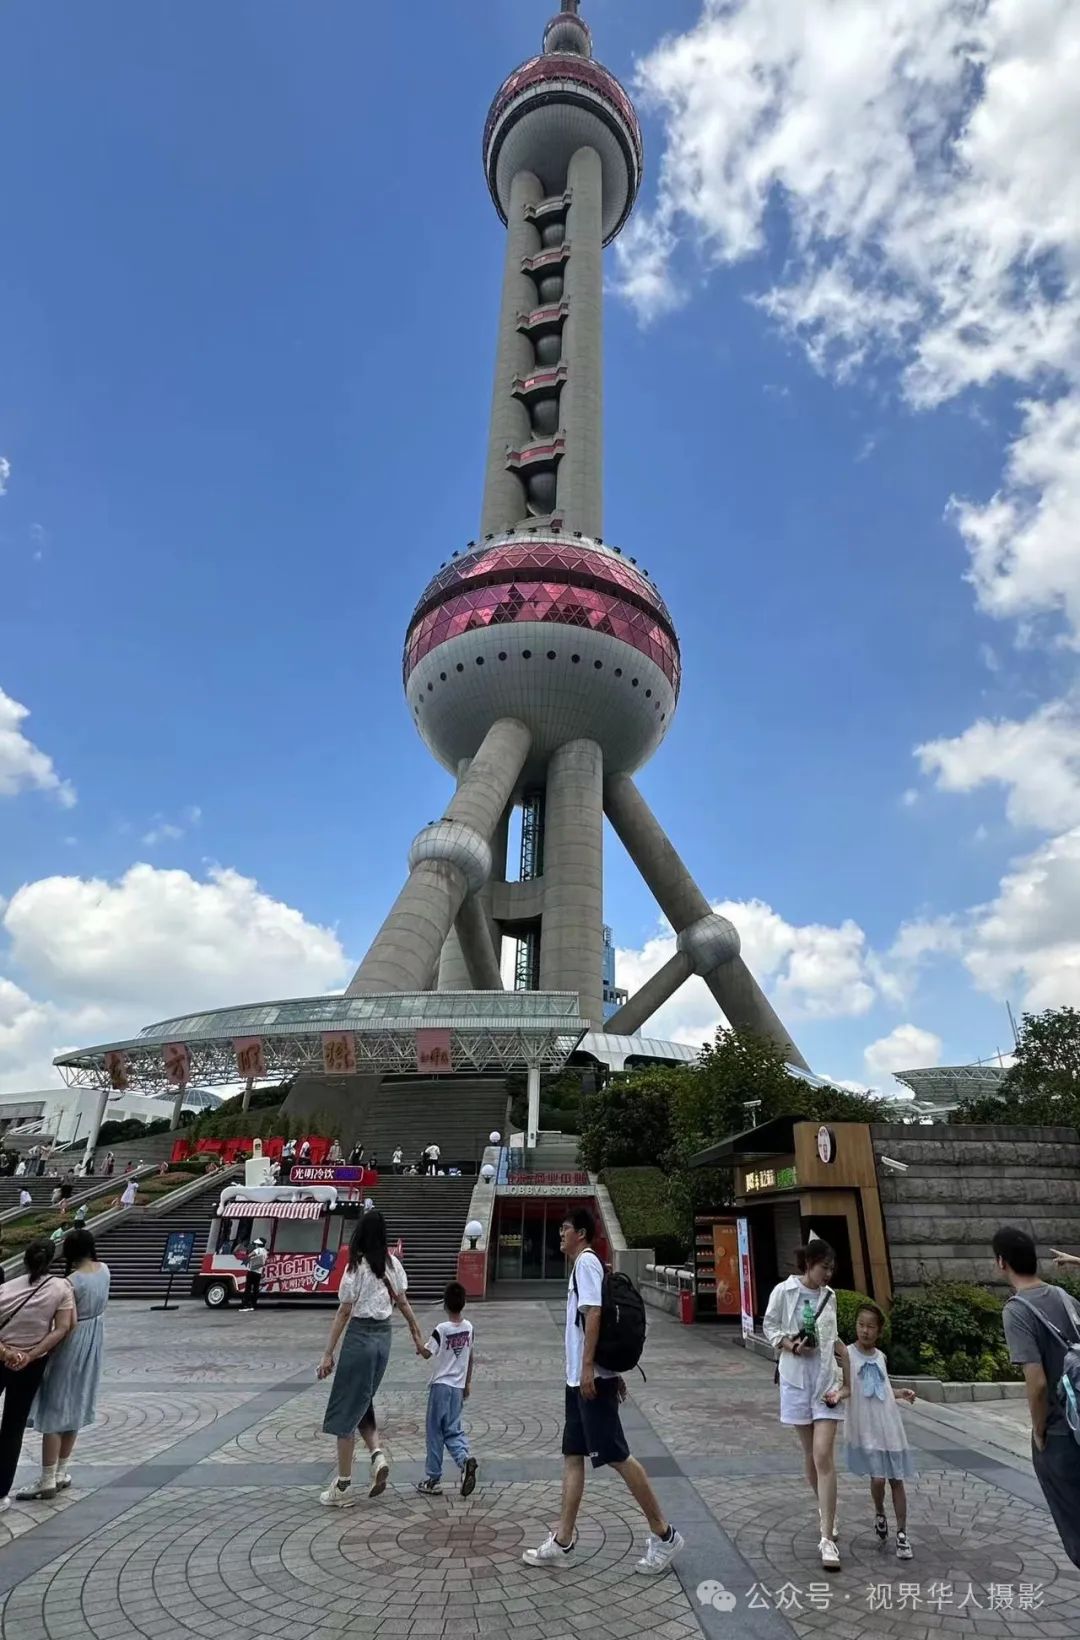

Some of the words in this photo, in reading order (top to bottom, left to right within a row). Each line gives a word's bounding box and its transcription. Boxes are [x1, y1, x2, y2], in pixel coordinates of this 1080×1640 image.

[293, 1168, 335, 1180] 光明冷饮
[551, 1185, 588, 1195] STORE
